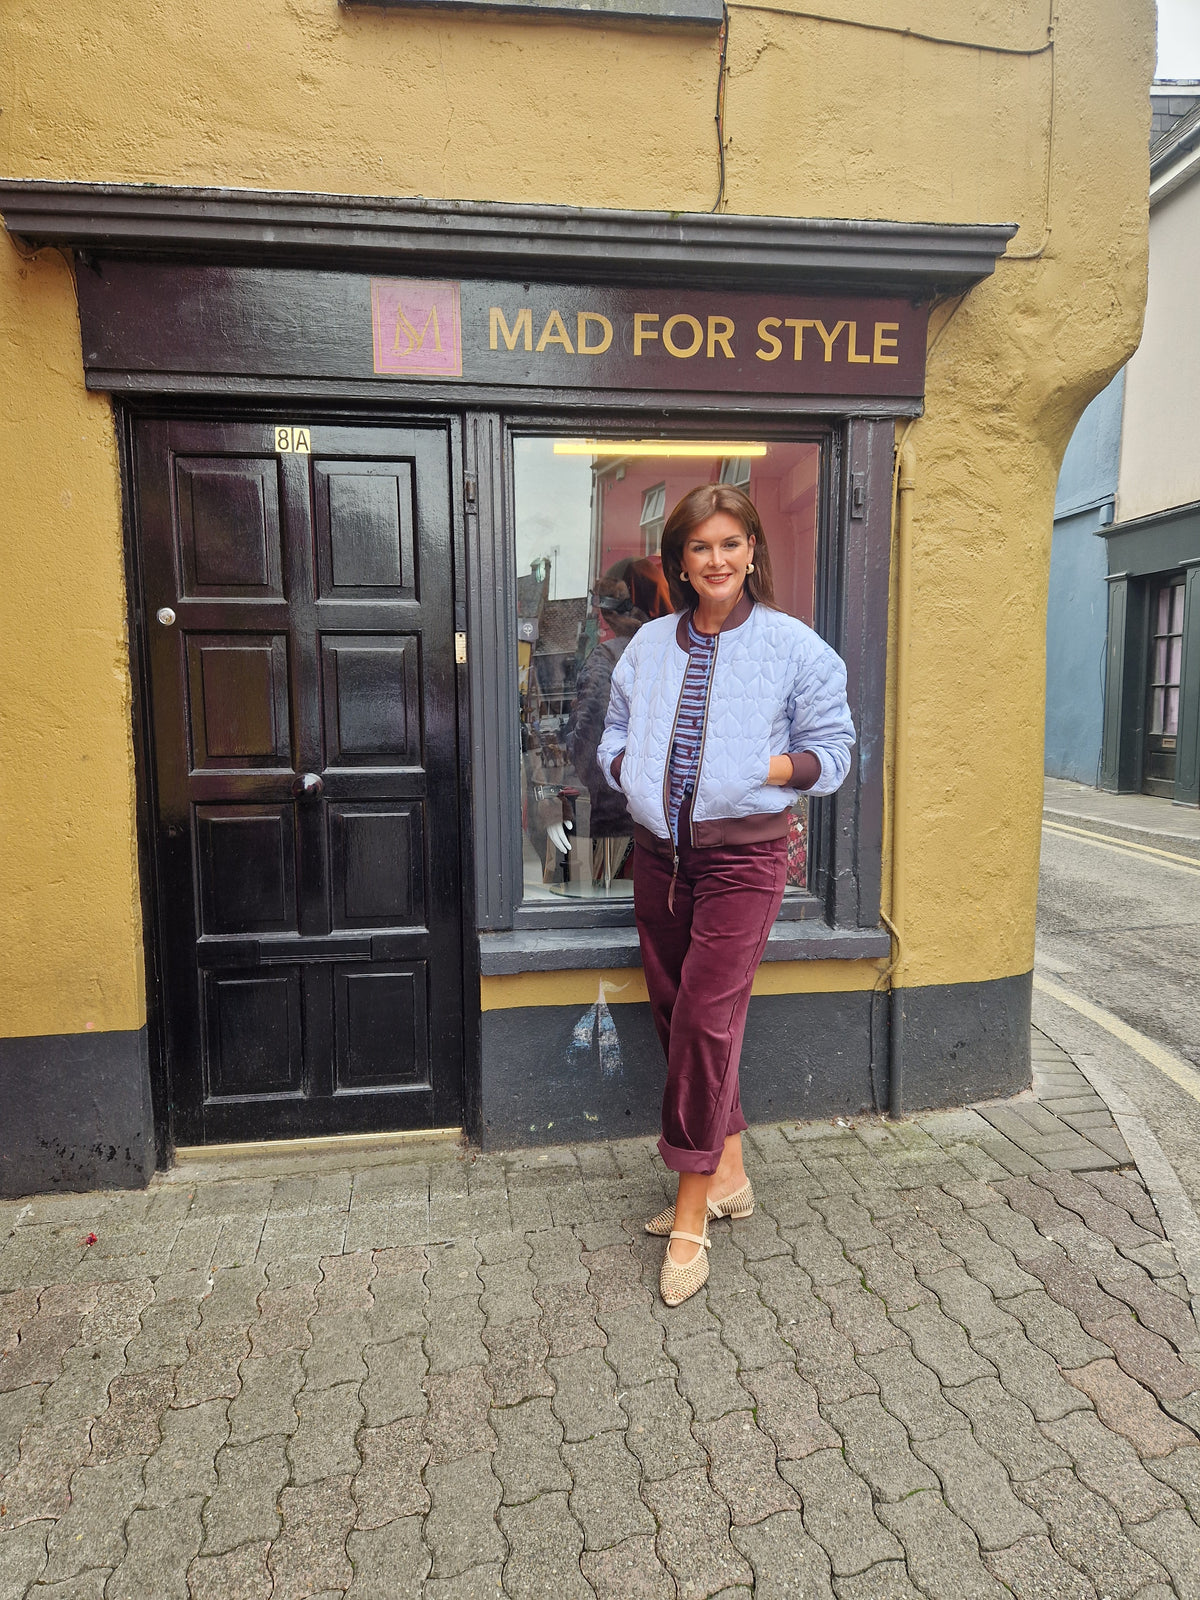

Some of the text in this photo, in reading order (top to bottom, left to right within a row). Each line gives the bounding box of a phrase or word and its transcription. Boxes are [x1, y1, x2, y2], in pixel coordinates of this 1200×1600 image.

[489, 307, 900, 364] MAD FOR STYLE
